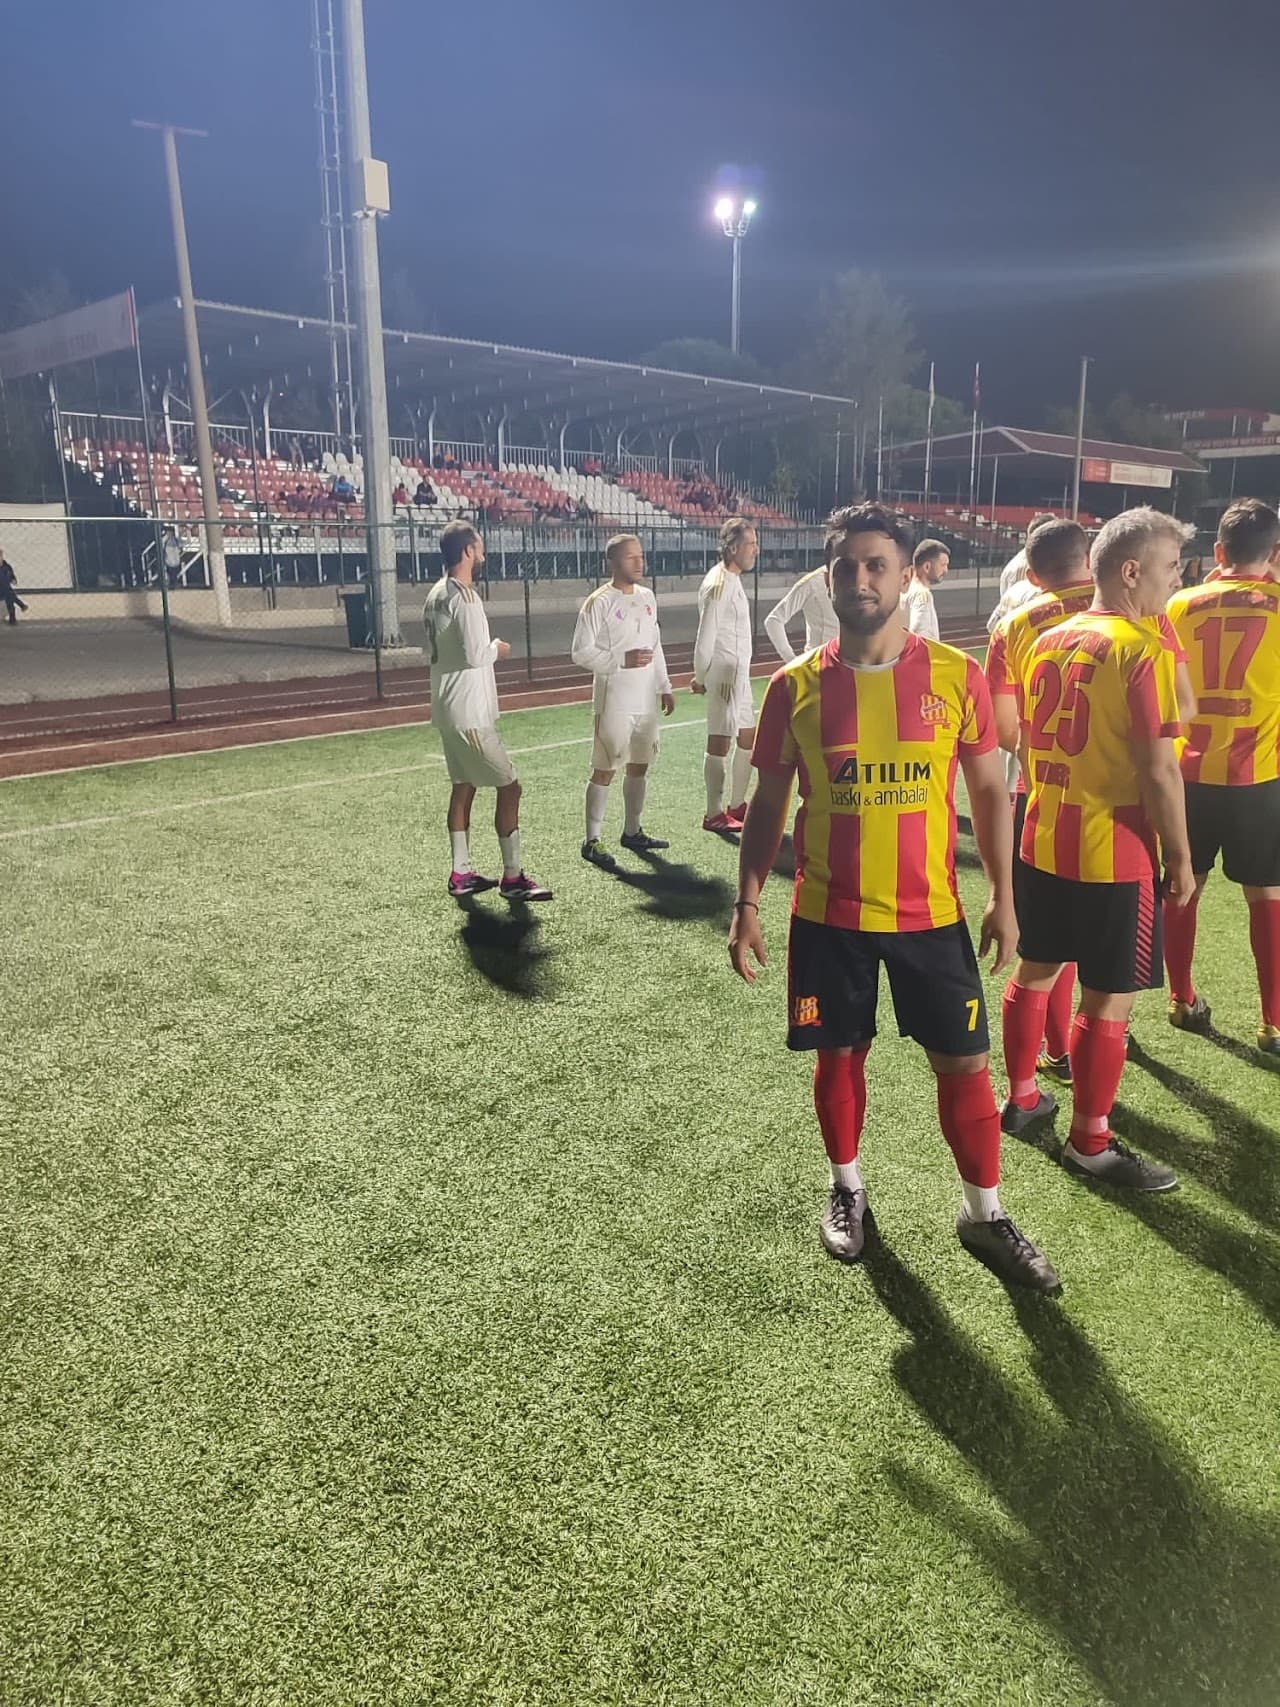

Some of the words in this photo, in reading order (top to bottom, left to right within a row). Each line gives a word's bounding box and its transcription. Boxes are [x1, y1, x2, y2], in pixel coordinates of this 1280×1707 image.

[1194, 616, 1267, 690] 17
[1030, 659, 1096, 757] 25
[833, 757, 931, 785] ATILIM
[863, 796, 872, 806] &
[874, 784, 928, 806] ambalaj
[966, 998, 979, 1032] 7
